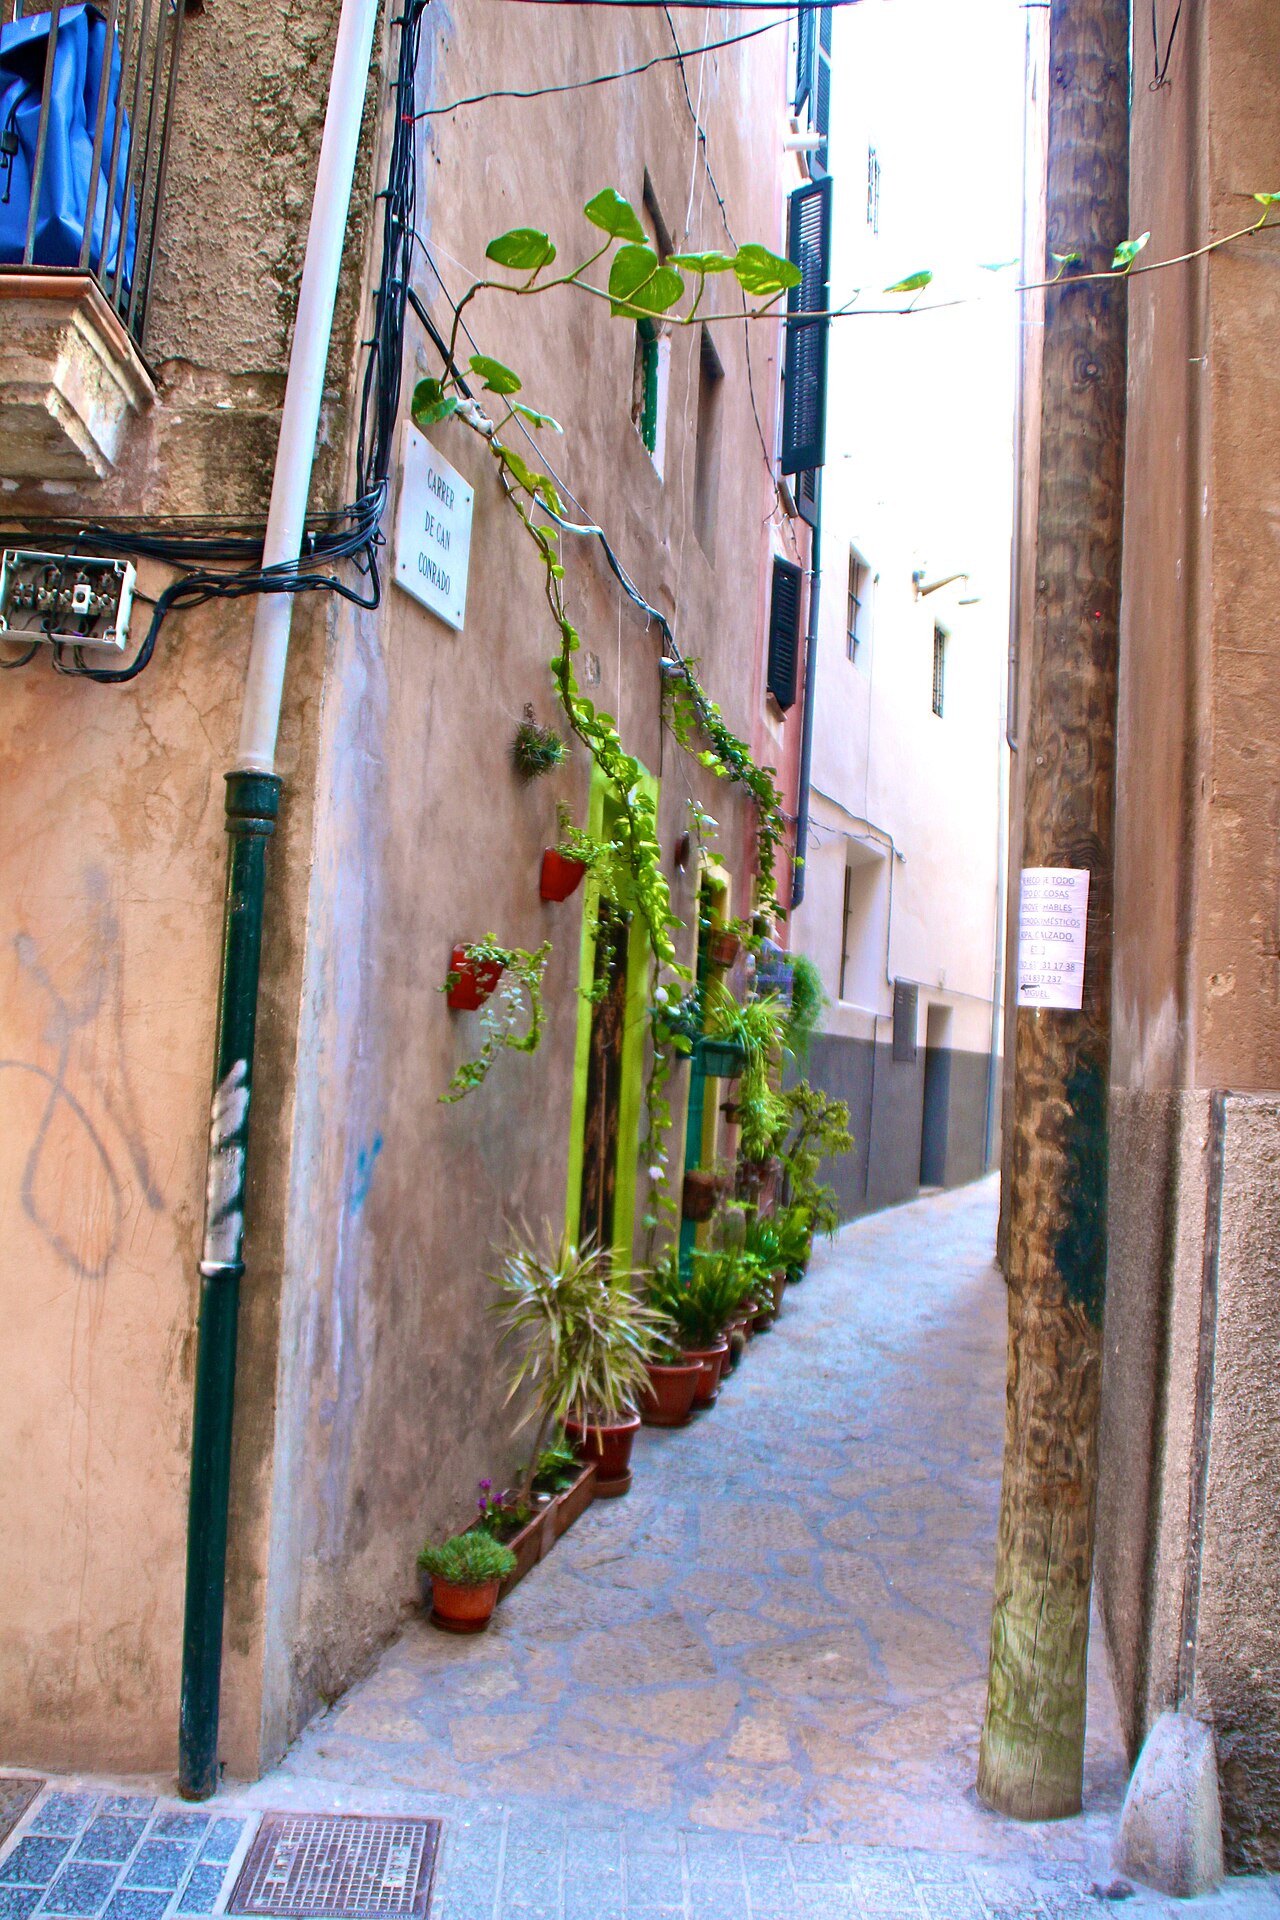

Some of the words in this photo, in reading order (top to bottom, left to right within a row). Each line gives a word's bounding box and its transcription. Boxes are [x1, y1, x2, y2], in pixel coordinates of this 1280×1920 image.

[427, 467, 455, 511] CARRER
[424, 510, 435, 539] DE
[436, 522, 452, 551] CAN
[418, 551, 451, 596] CONRADO
[1043, 889, 1070, 898] COSAS
[1052, 876, 1075, 886] TODO
